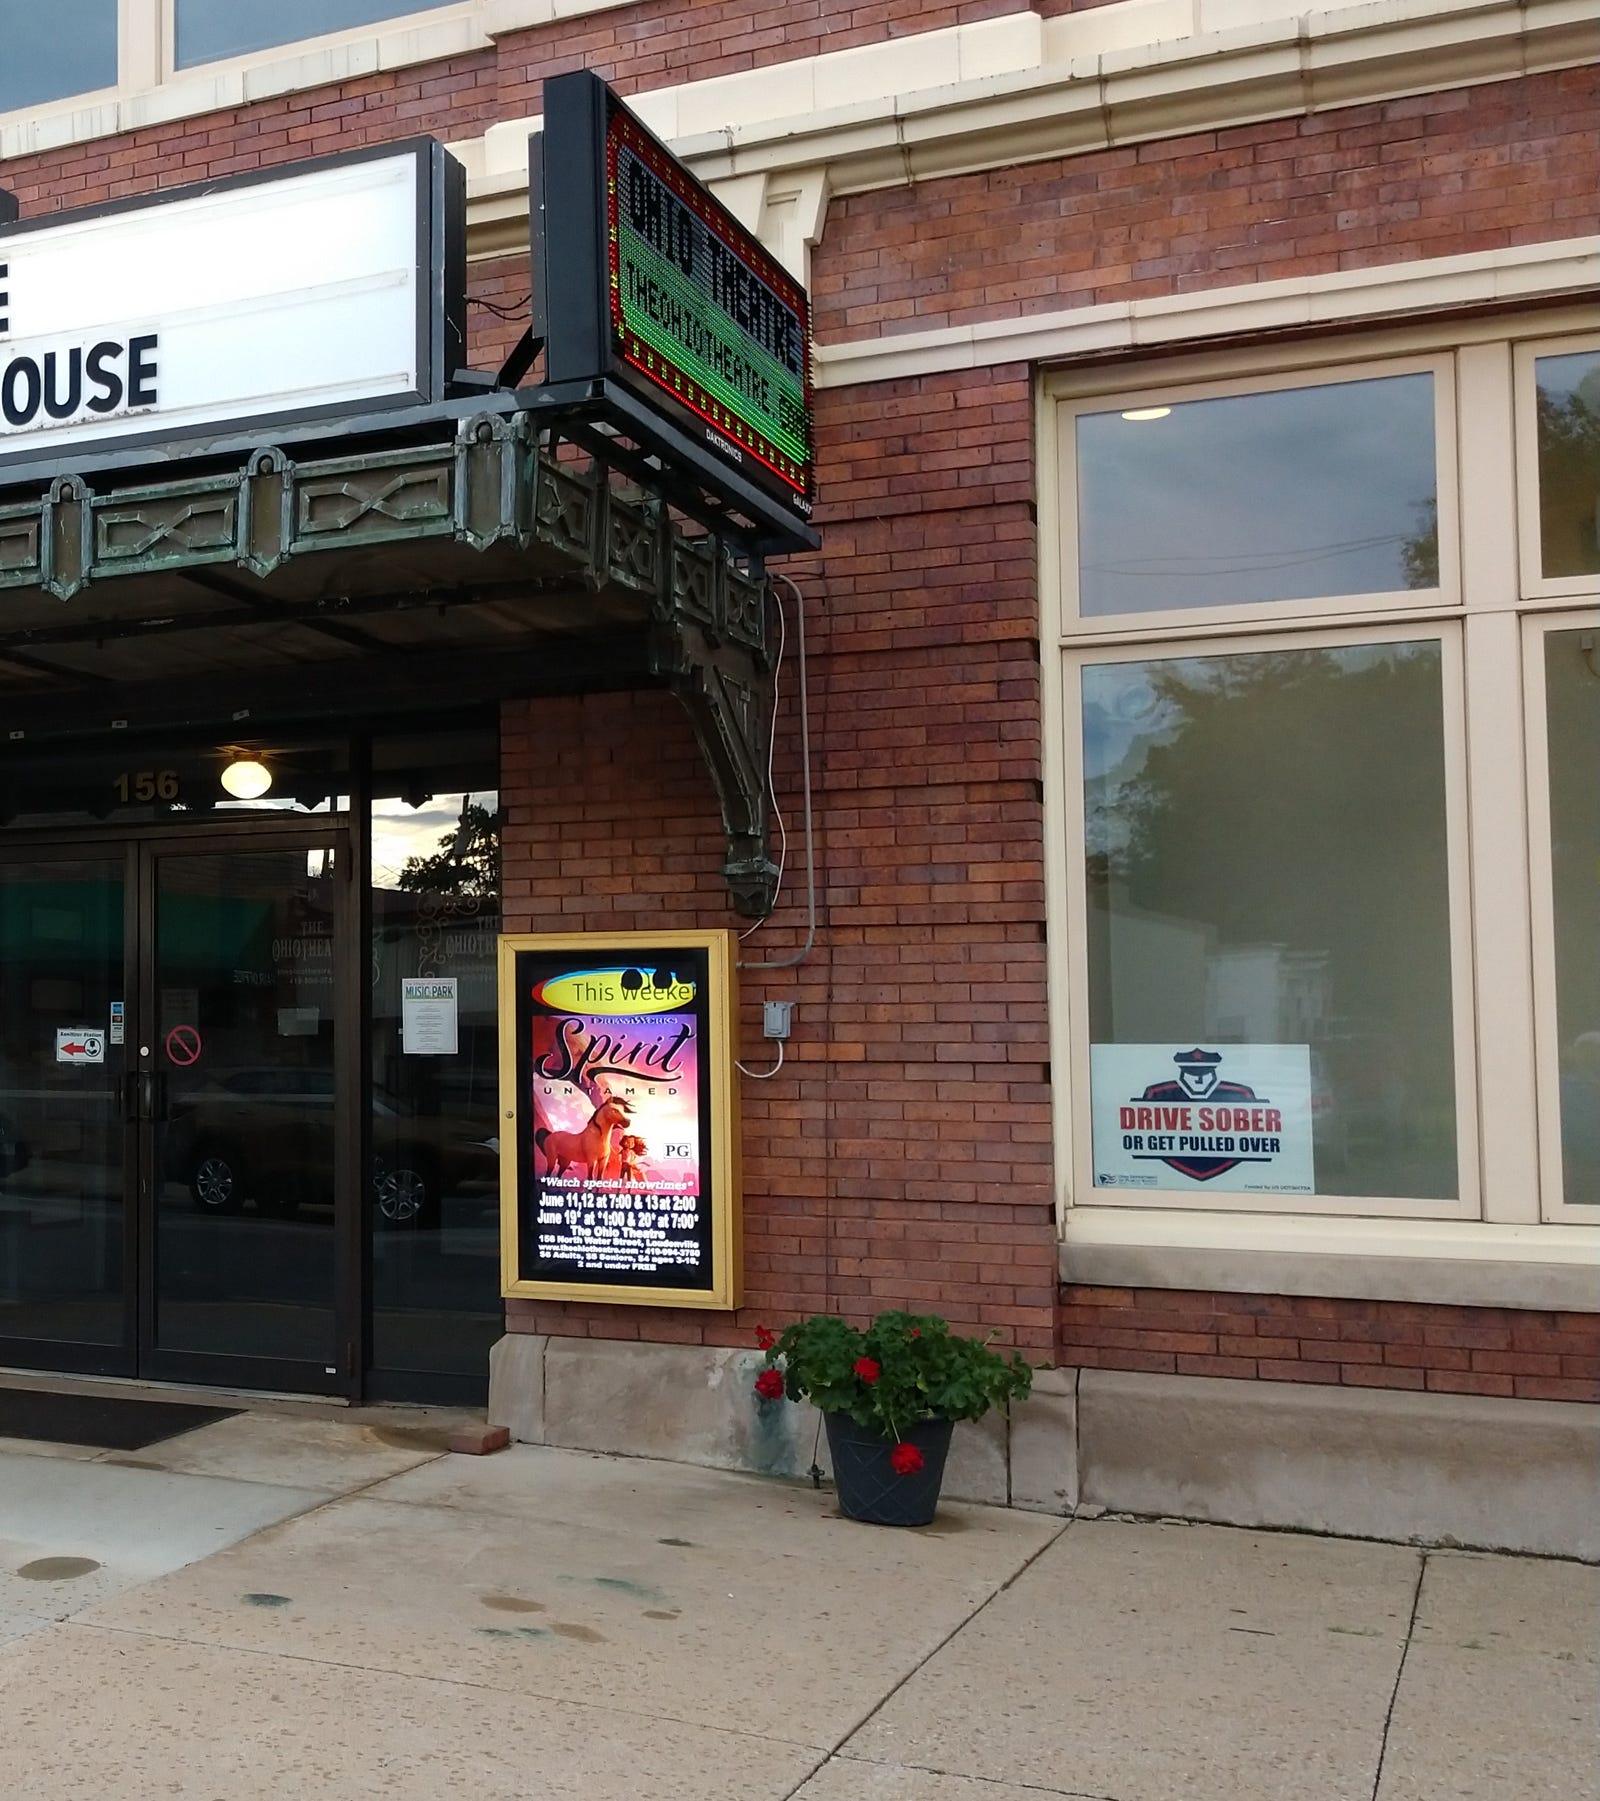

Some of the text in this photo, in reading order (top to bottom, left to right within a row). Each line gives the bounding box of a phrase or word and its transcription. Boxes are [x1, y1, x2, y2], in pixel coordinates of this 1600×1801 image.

[629, 160, 799, 374] OHIO THEATRE
[705, 428, 743, 464] DAKTRONICS
[113, 769, 178, 802] 156
[405, 985, 454, 999] MUSIC PARK
[572, 982, 614, 1001] This
[535, 1018, 697, 1082] Spirit
[544, 1087, 678, 1095] UNTAMED
[1119, 1106, 1282, 1132] DRIVE SOBER
[665, 1145, 690, 1157] PG
[1122, 1134, 1280, 1153] OR GET PULLED OVER
[583, 1178, 622, 1190] special
[539, 1191, 696, 1211] June 11,12 at 7:00 & 13 at 2:00
[537, 1209, 562, 1224] June
[584, 1211, 595, 1225] at
[626, 1211, 636, 1226] &
[657, 1213, 670, 1228] at
[570, 1225, 666, 1239] The Ohio Theatre
[557, 1235, 583, 1244] North
[584, 1236, 612, 1245] Water
[612, 1237, 644, 1248] Street,
[646, 1239, 699, 1249] Loudonville
[553, 1251, 584, 1260] Adults,
[599, 1254, 636, 1263] Seniors,
[651, 1257, 674, 1265] ages
[632, 1263, 657, 1271] FREE
